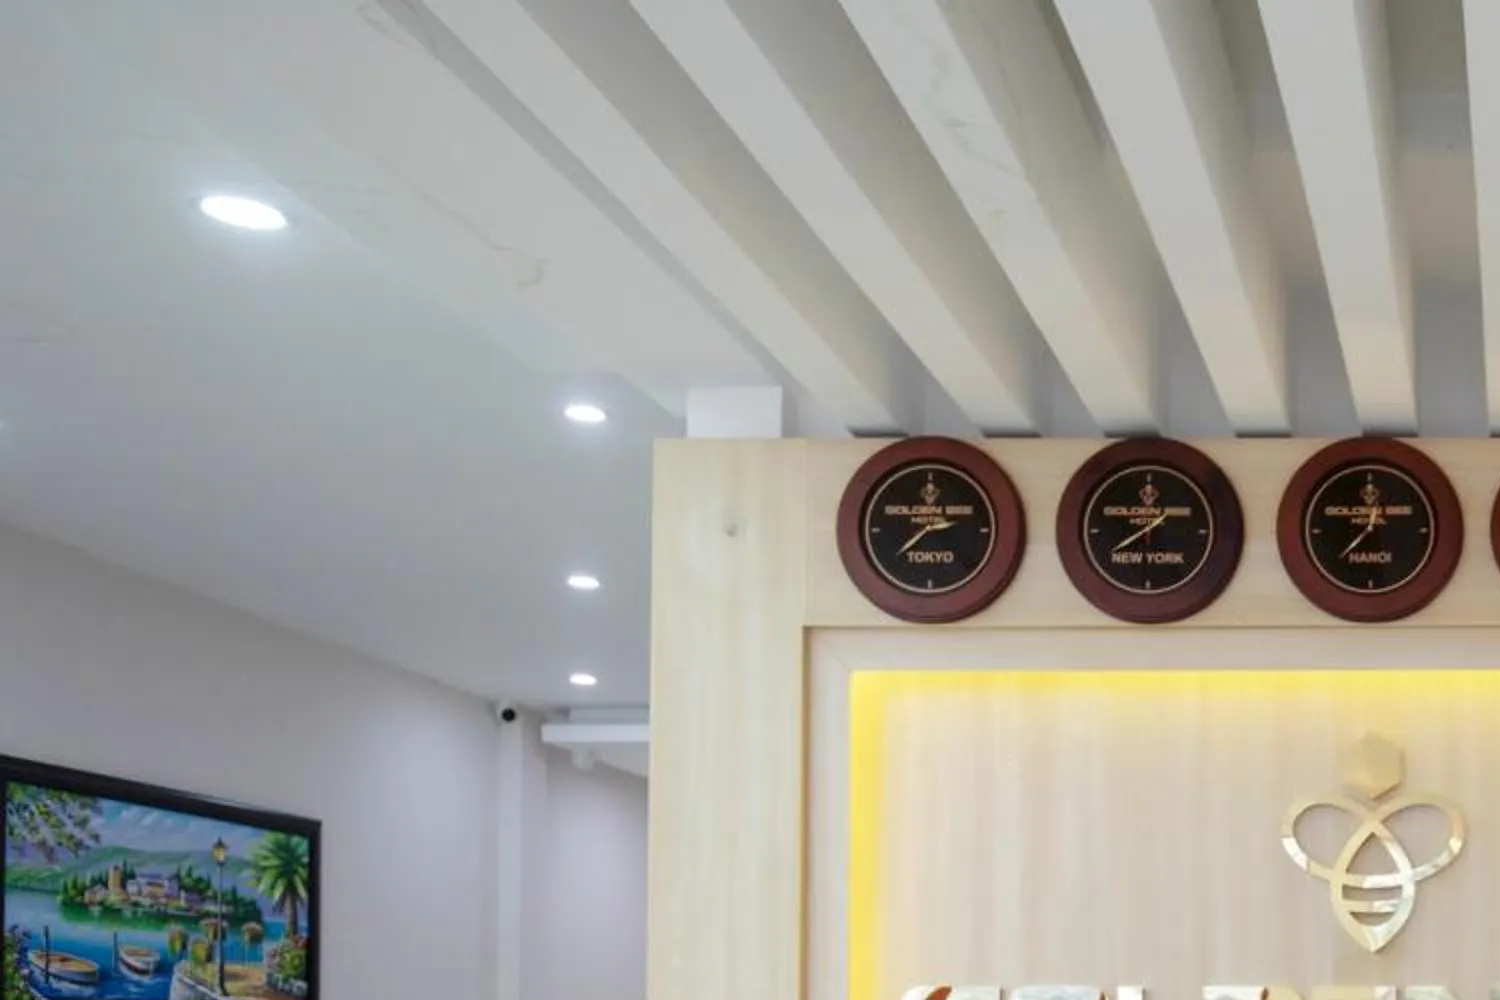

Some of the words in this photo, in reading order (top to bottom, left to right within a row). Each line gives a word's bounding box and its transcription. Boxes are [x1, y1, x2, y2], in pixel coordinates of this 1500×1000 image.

[885, 505, 943, 514] GOLDEN
[1103, 506, 1162, 516] GOLDEN
[907, 551, 954, 563] TOKYO
[1112, 551, 1143, 564] NEW
[1146, 551, 1184, 564] YORK
[1348, 551, 1392, 564] HANOI
